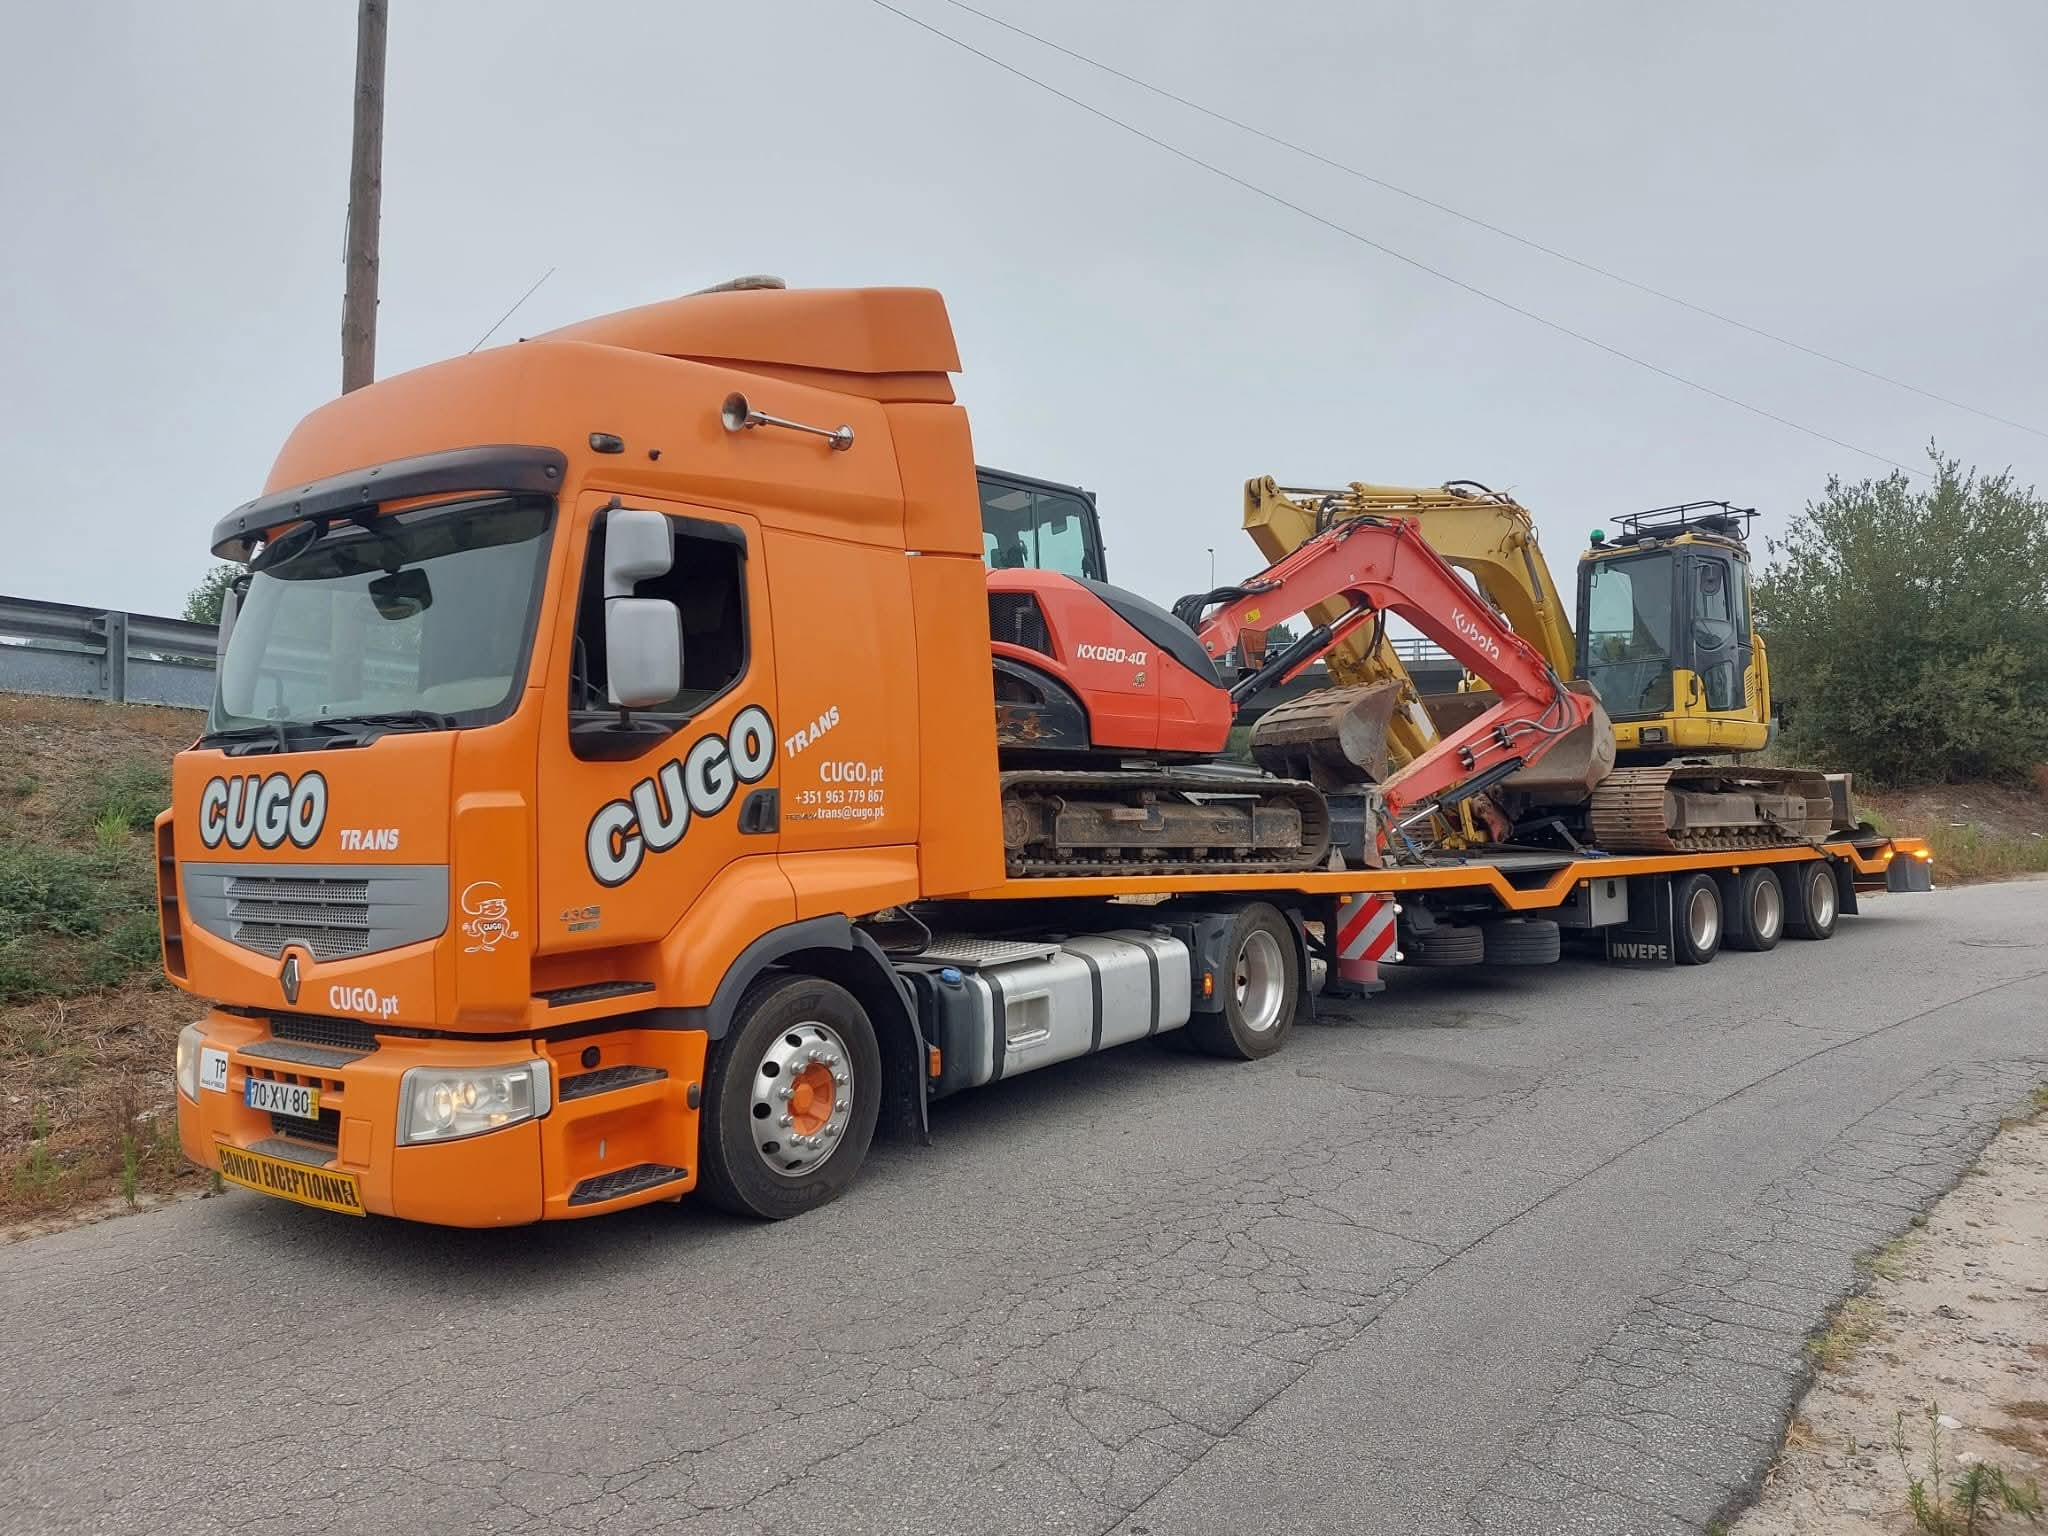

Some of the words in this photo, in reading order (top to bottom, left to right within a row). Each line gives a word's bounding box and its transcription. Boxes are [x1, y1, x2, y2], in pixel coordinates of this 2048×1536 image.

[1452, 607, 1500, 660] Kubota
[784, 705, 840, 758] TRANS
[820, 761, 884, 787] CUGO.pt
[200, 770, 328, 850] CUGO
[586, 704, 776, 888] CUGO
[795, 791, 822, 805] +351
[825, 790, 845, 804] 963
[847, 789, 866, 803] 779
[867, 789, 885, 803] 867
[817, 805, 885, 821] trans@cugo.pt
[340, 829, 400, 850] TRANS
[1612, 943, 1668, 960] INVEPE
[329, 985, 399, 1019] CUGO.pt
[215, 1058, 227, 1079] TP
[219, 1148, 262, 1185] CONVOI
[261, 1160, 360, 1208] EXCEPTIONNEL
